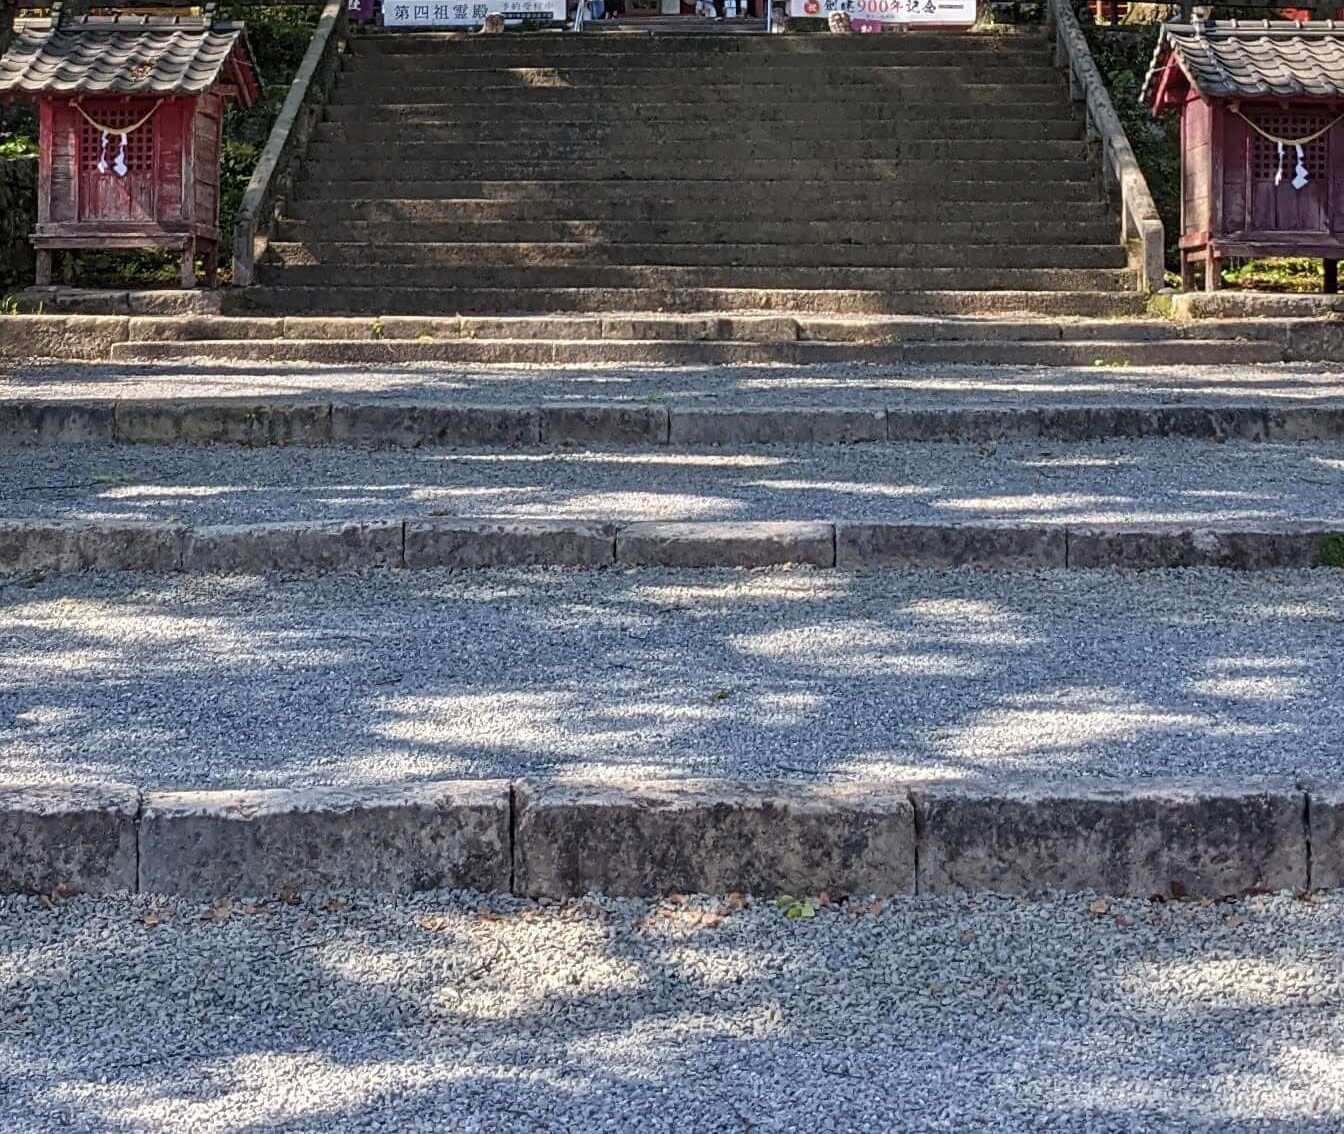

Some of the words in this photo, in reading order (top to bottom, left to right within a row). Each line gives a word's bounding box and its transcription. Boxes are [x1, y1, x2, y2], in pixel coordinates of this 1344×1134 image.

[394, 4, 489, 20] 第四祖霊殿
